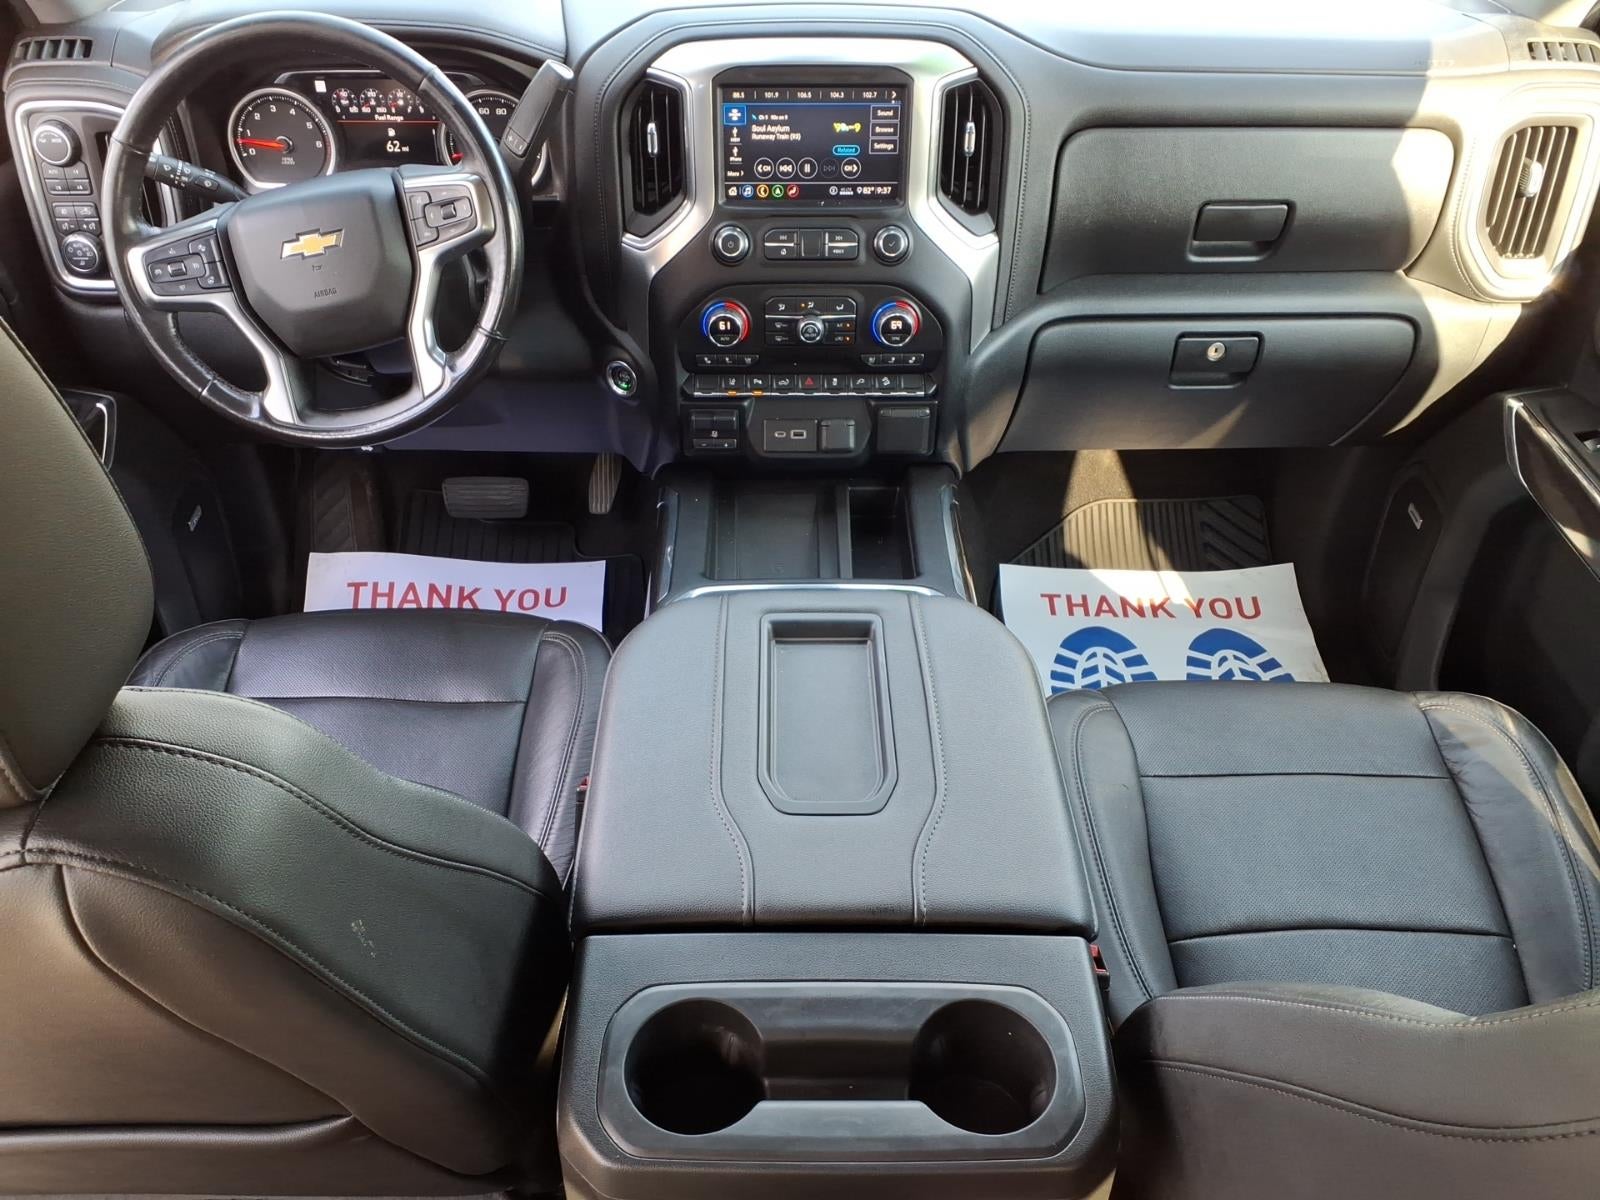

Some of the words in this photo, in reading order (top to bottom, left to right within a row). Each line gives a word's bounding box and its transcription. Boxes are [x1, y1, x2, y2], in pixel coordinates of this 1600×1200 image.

[270, 104, 277, 112] 3
[478, 107, 490, 115] 60
[495, 107, 507, 115] 80
[254, 112, 261, 120] 2
[387, 114, 404, 122] Range
[306, 121, 313, 129] 5
[751, 124, 766, 132] Soul
[766, 124, 790, 134] Asylum
[751, 133, 776, 141] Runaway
[315, 140, 323, 148] 6
[386, 140, 401, 152] 62
[873, 142, 894, 151] Settings
[876, 186, 891, 194] 9:37
[313, 287, 338, 299] AIRBAG
[718, 320, 731, 331] 61
[890, 320, 903, 330] 69
[346, 581, 482, 610] THANK
[493, 586, 567, 612] YOU
[1040, 593, 1176, 619] THANK
[1184, 596, 1262, 619] YOU
